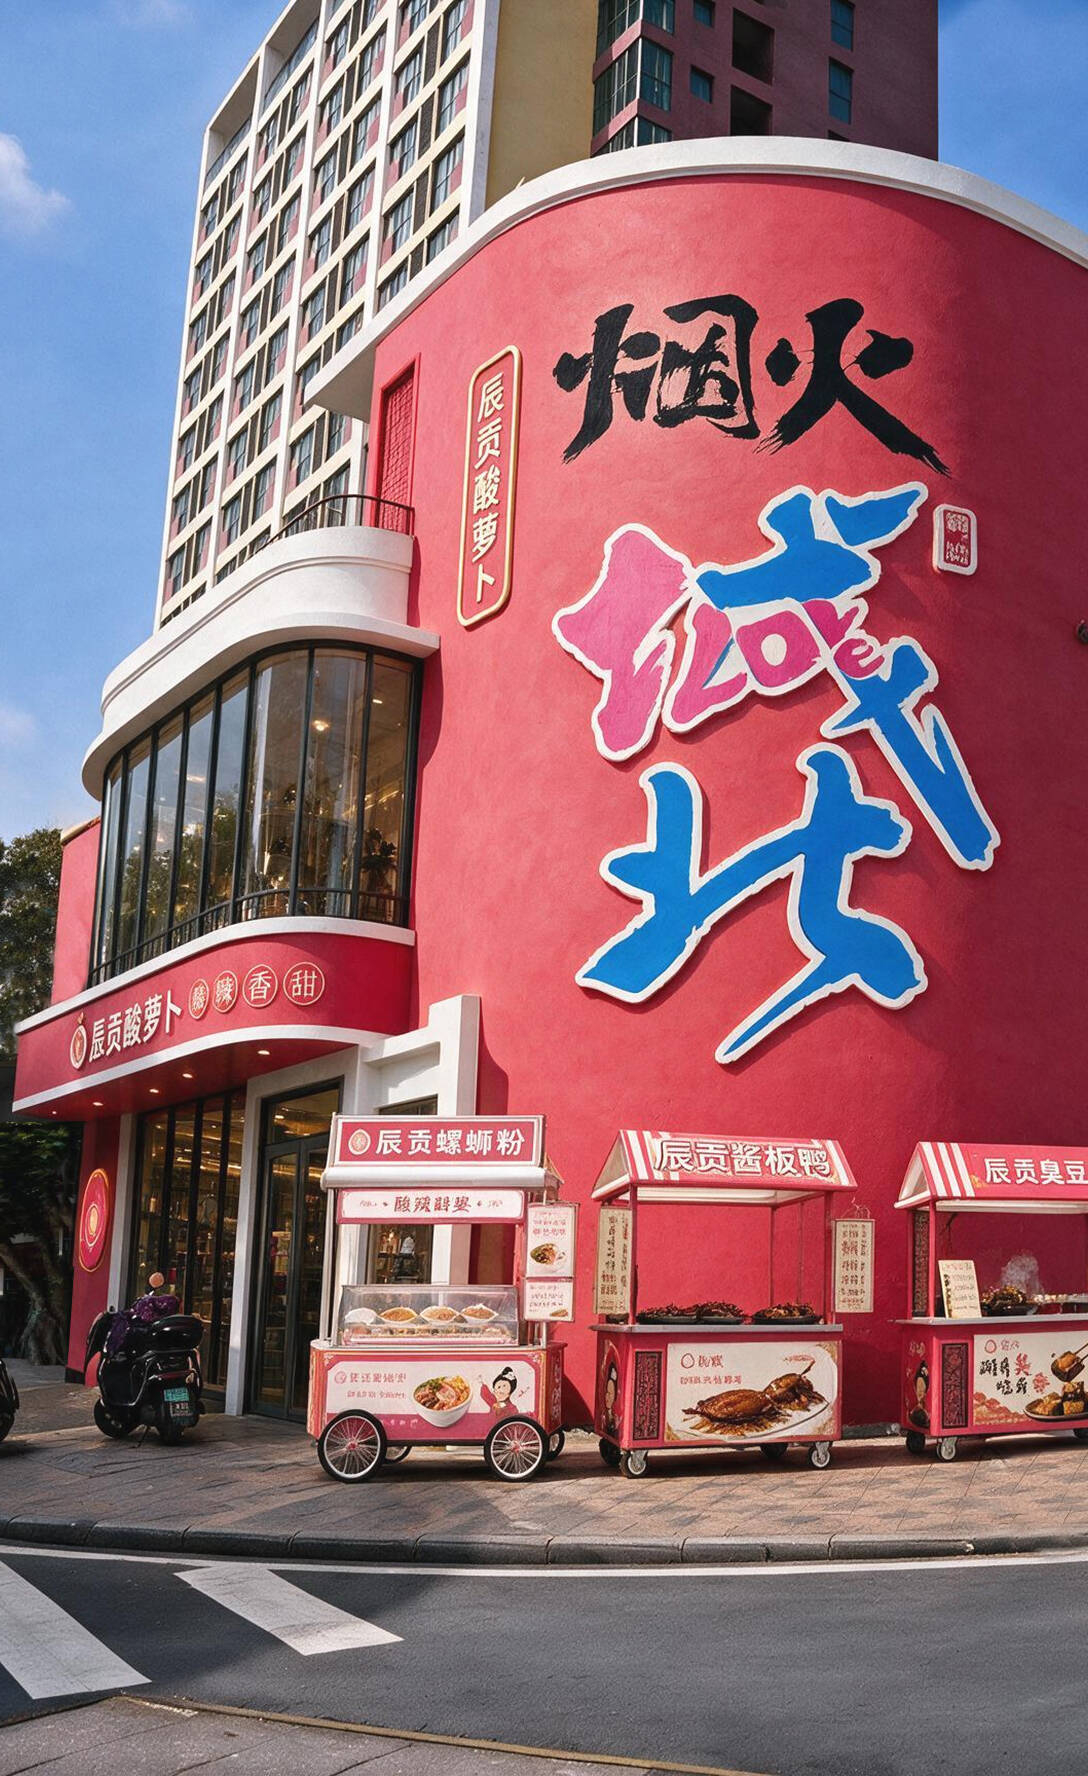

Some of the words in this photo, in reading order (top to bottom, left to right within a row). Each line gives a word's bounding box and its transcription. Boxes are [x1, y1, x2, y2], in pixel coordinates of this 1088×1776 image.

[472, 373, 504, 602] 辰贡酸萝卜
[88, 989, 182, 1064] 辰贡酸萝卜
[374, 1128, 525, 1157] 辰贡螺蛳粉
[654, 1139, 831, 1178] 辰贡酱板鸭
